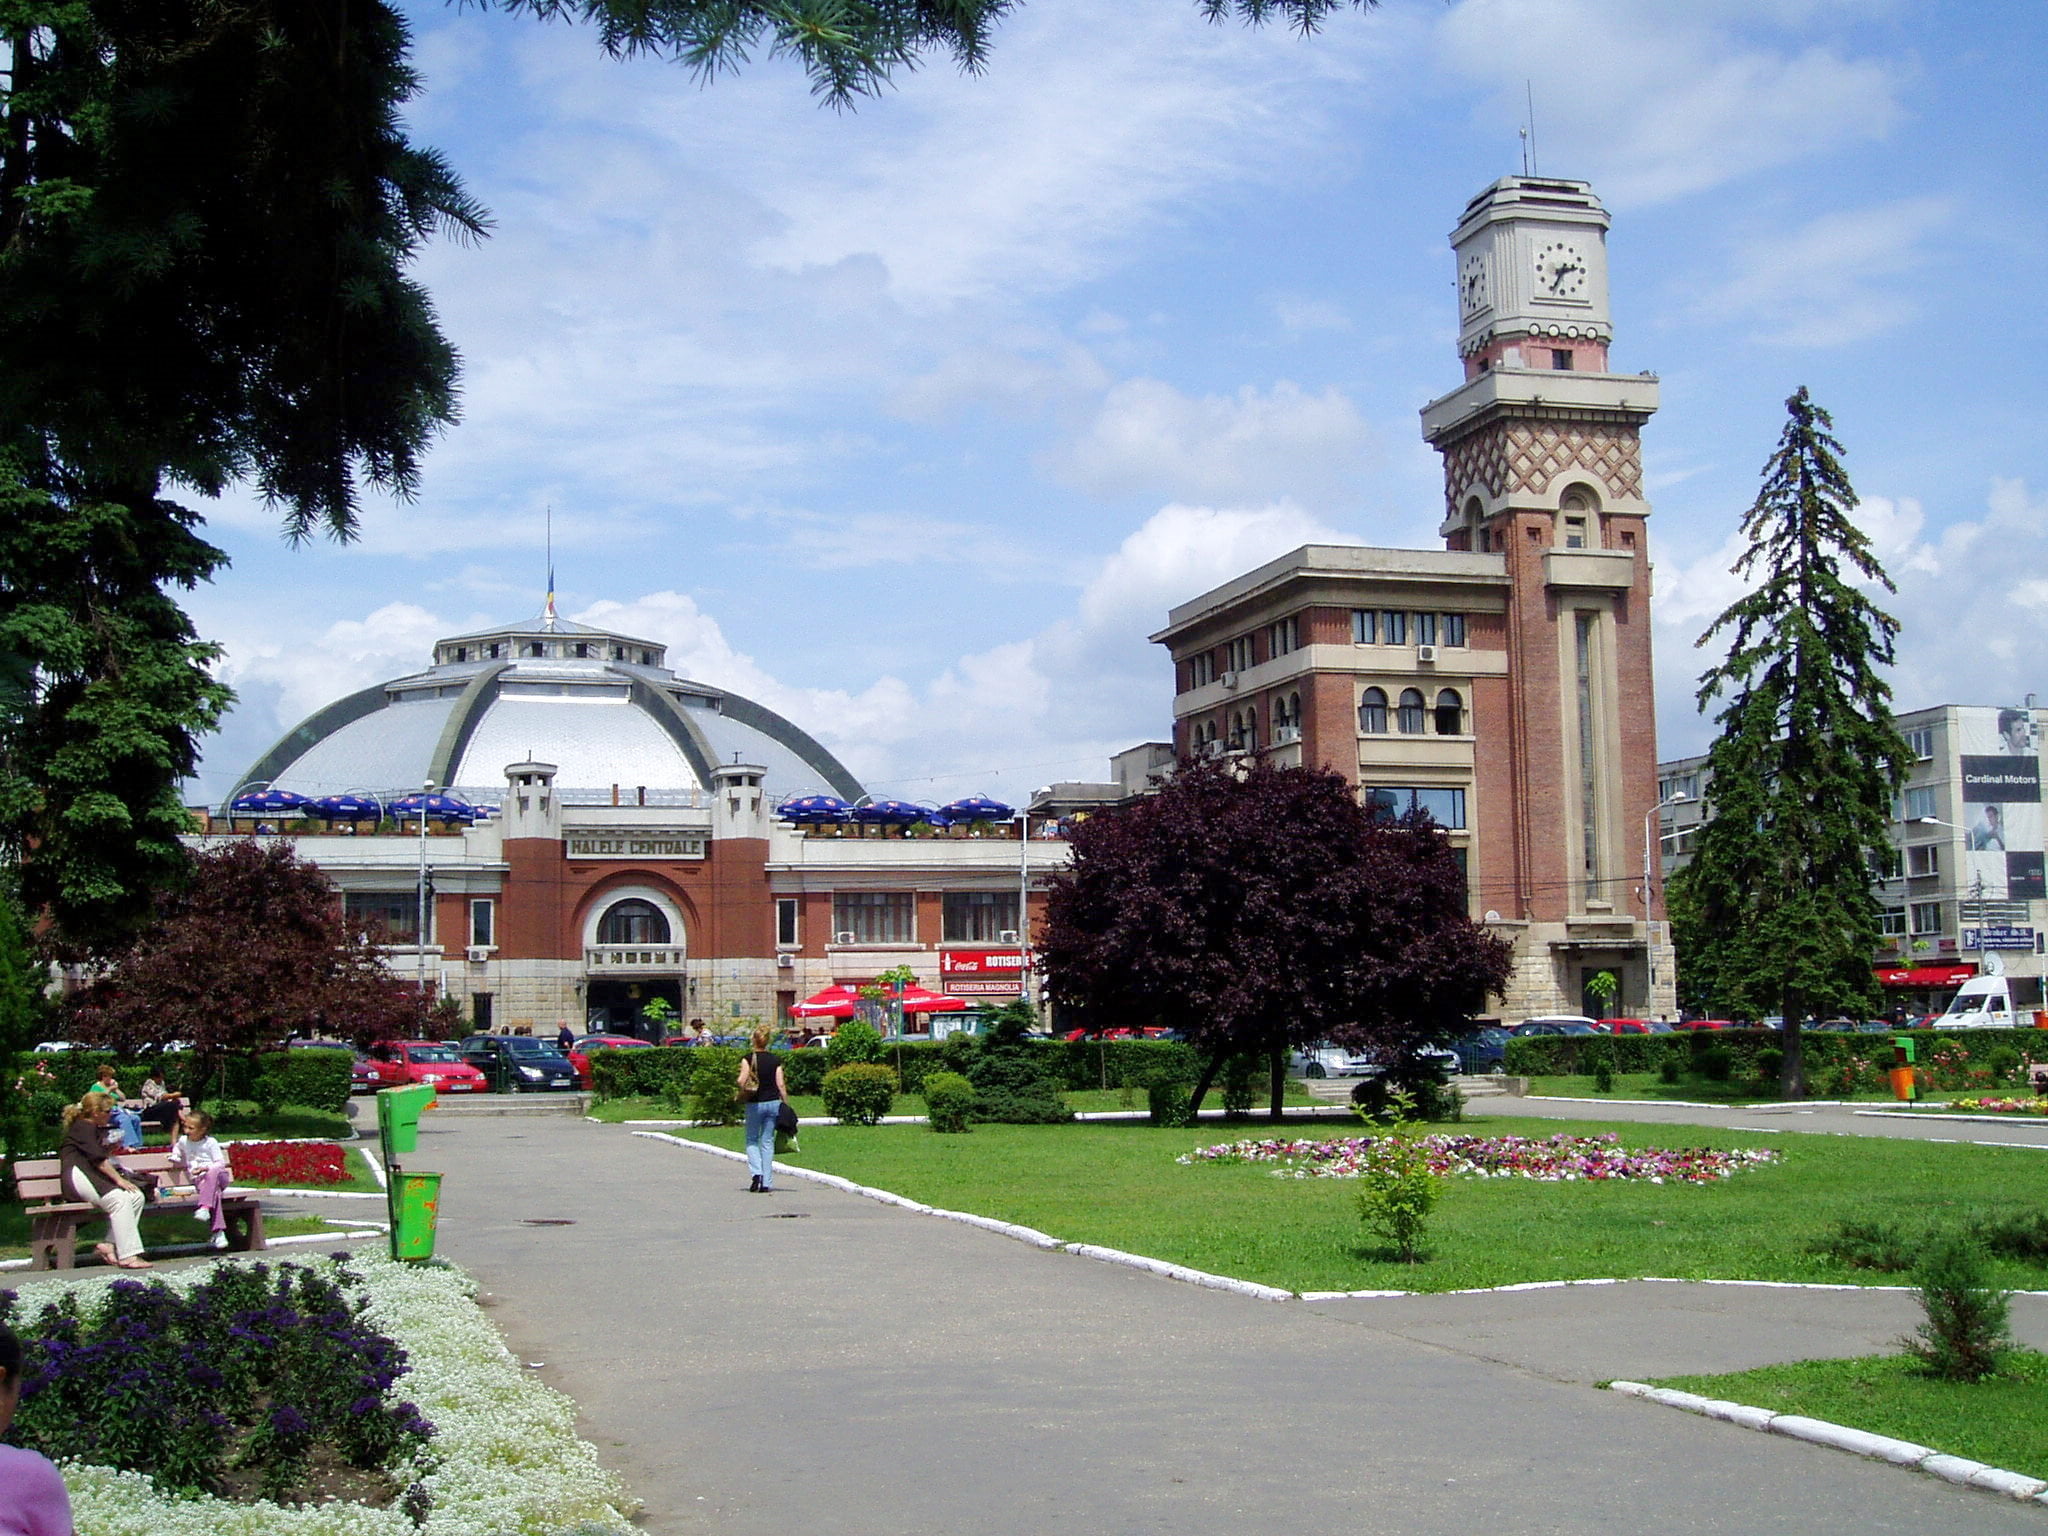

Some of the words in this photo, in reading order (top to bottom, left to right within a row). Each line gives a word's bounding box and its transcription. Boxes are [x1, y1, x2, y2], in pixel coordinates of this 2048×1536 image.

[1965, 774, 2003, 784] Cardinal
[2004, 774, 2037, 784] Motors
[571, 840, 625, 854] HALELE
[630, 840, 700, 854] CENTRALE
[985, 956, 1030, 967] ROTISERE
[985, 983, 1020, 991] MAGNOLIA
